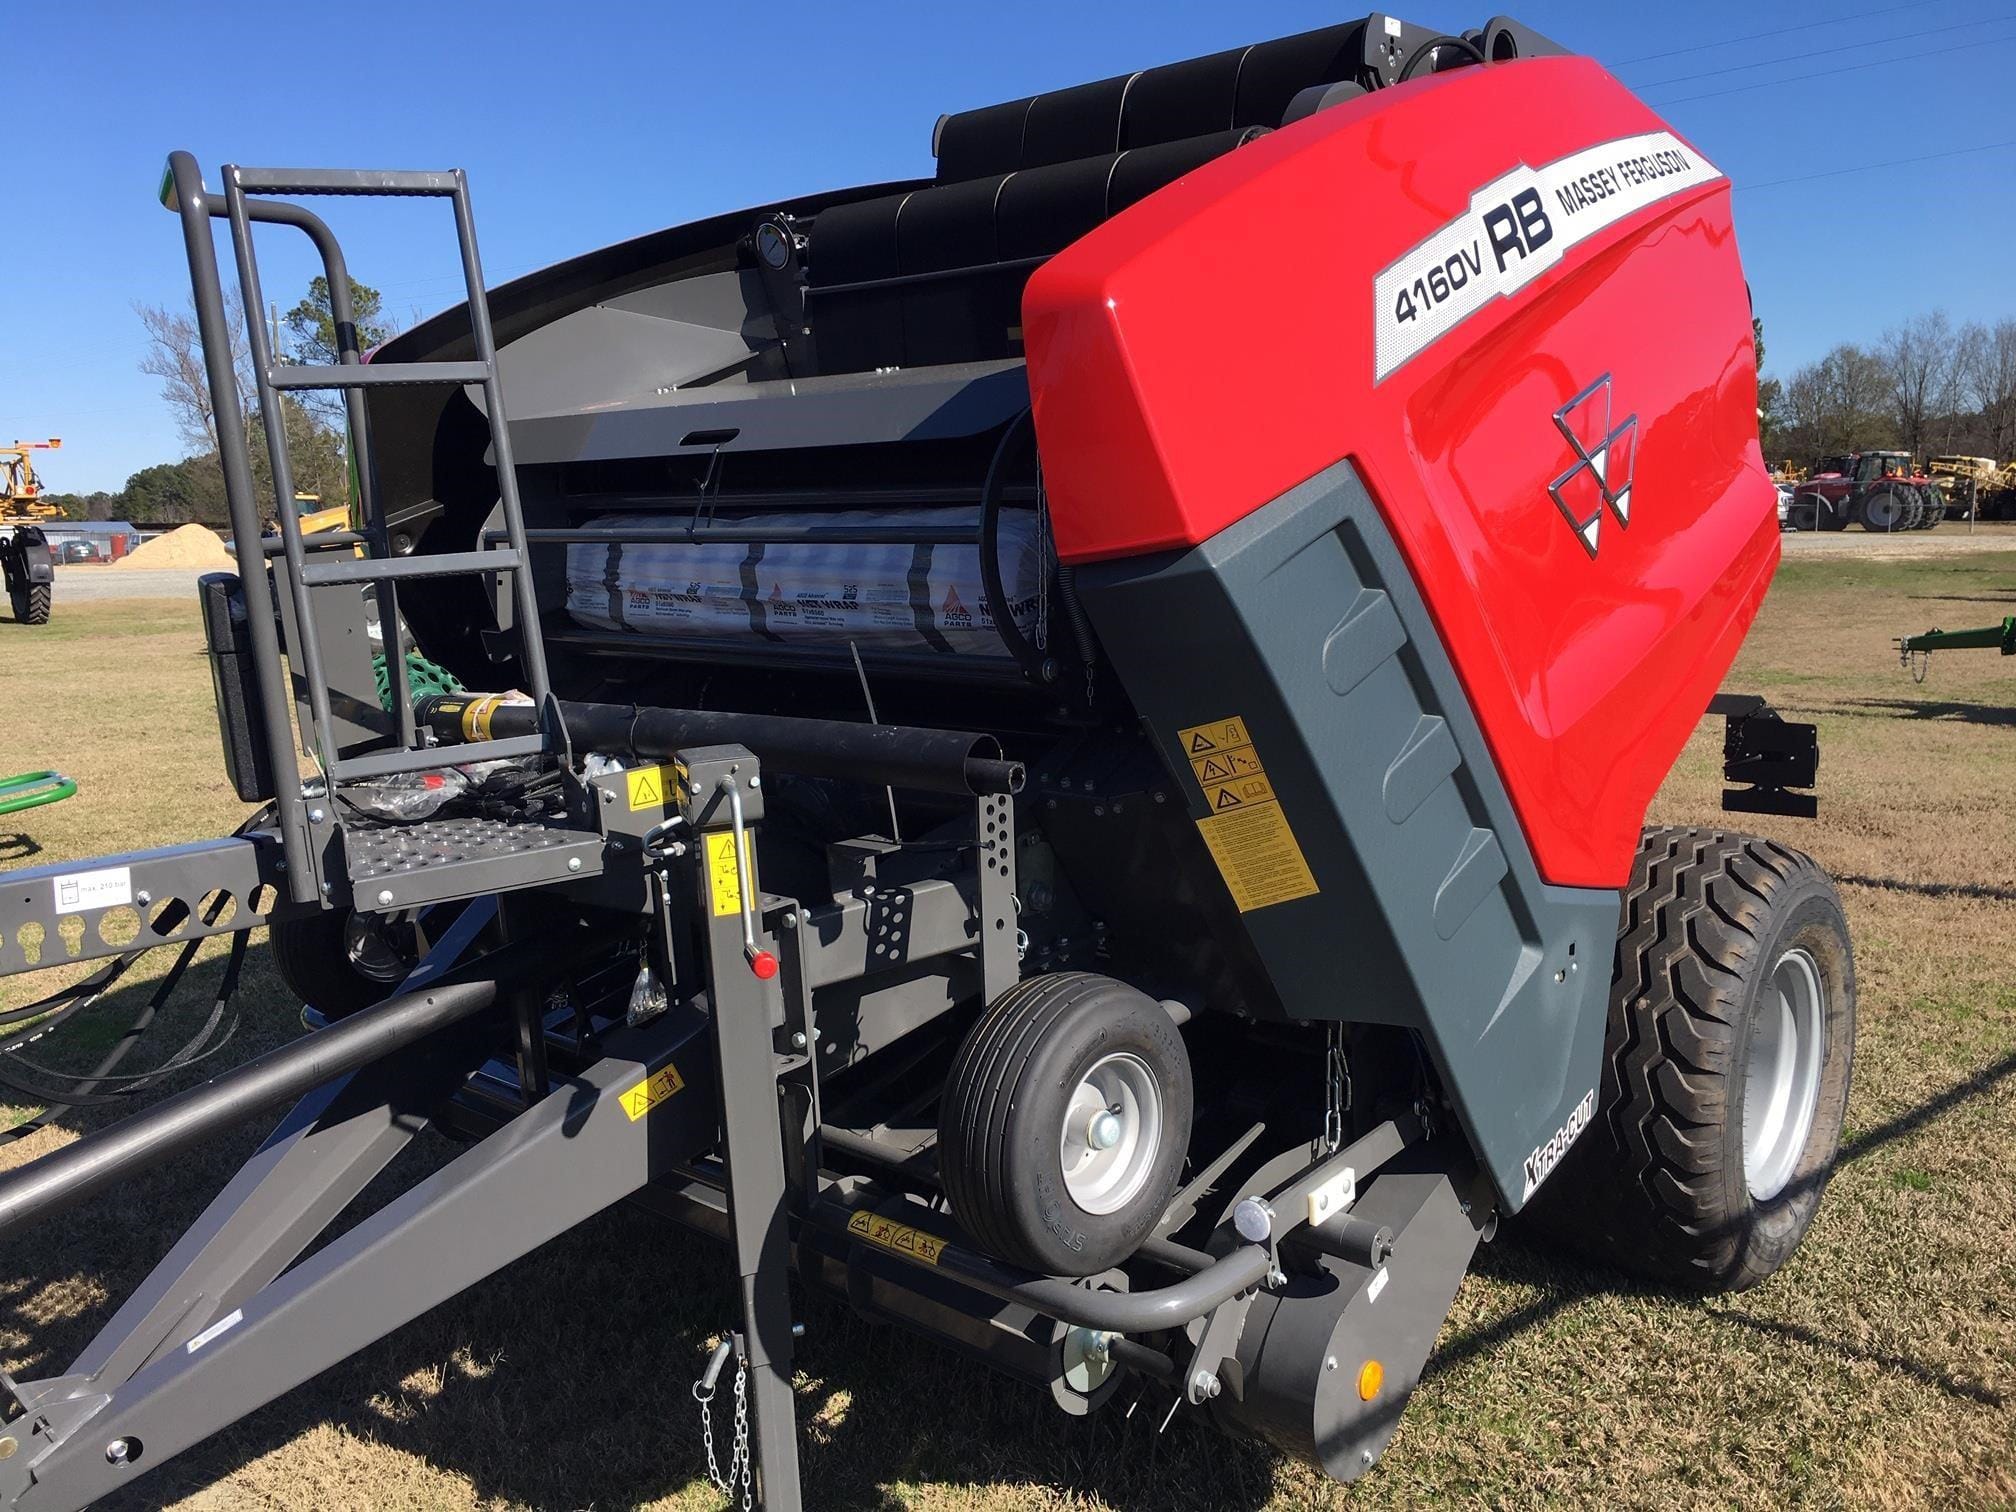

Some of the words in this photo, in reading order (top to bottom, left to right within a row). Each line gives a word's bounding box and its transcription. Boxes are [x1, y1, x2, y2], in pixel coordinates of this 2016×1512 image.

[1555, 166, 1622, 216] MASSEY
[1618, 149, 1691, 188] FERGUSON
[1395, 240, 1483, 324] 4160V
[1483, 186, 1554, 273] RB
[844, 584, 858, 594] 525
[944, 613, 972, 621] AGCO
[100, 882, 113, 890] 210
